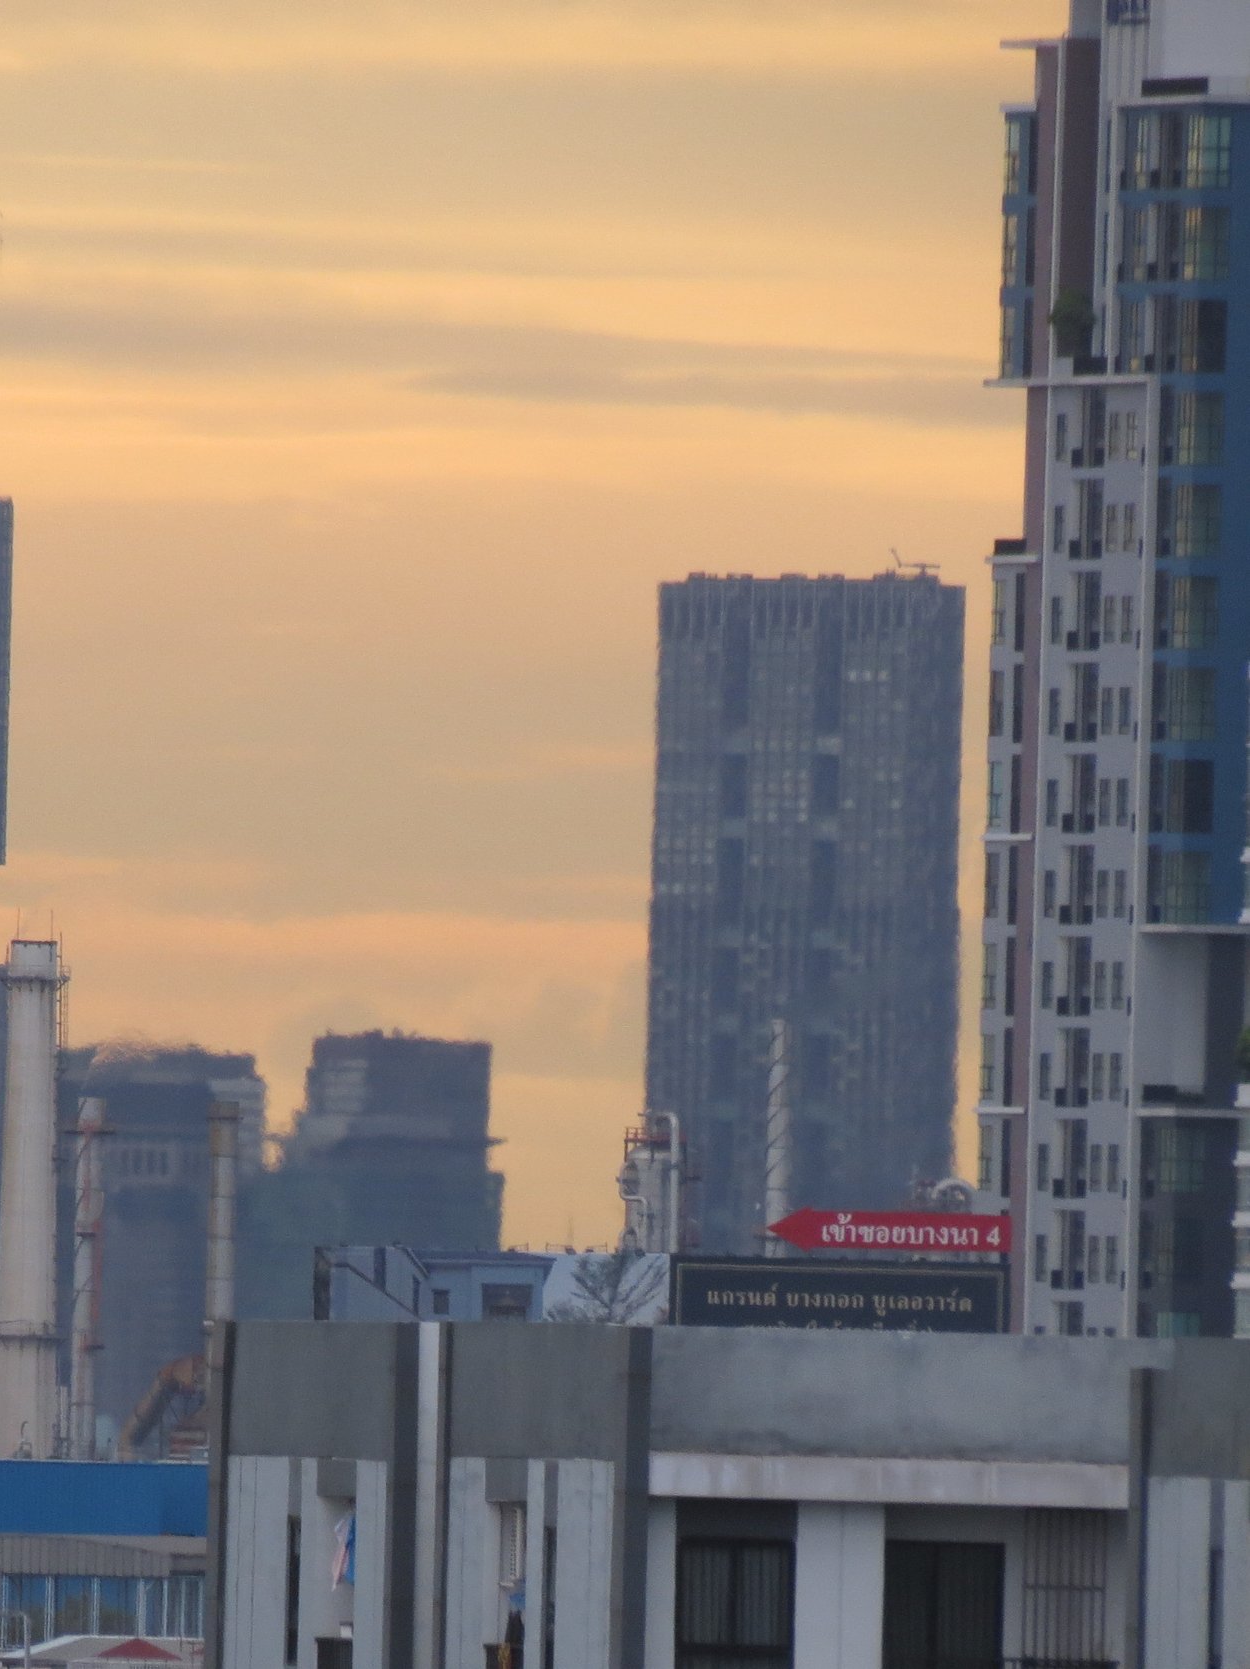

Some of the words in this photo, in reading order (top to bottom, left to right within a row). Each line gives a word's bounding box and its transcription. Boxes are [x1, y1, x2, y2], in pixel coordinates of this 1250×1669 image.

[821, 1213, 978, 1246] เข้าซอยบางนา
[985, 1225, 1001, 1246] 4
[786, 1292, 865, 1309] บางกอก
